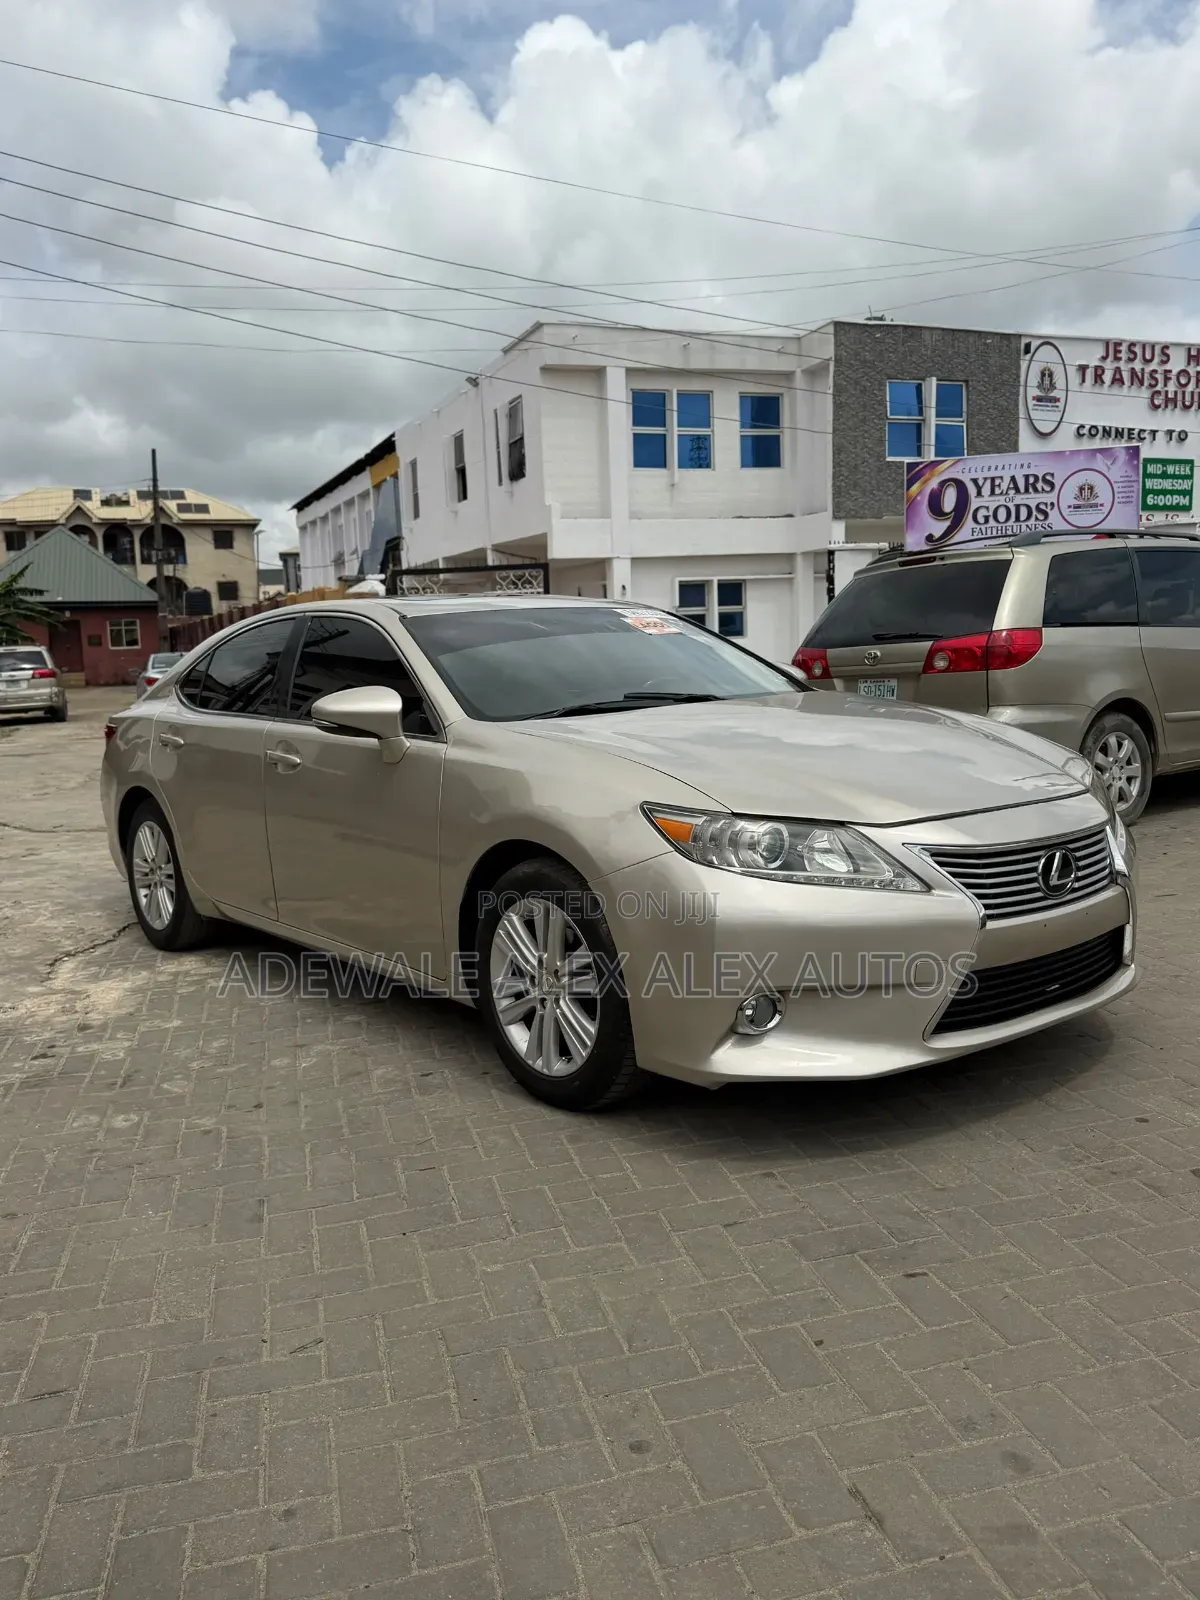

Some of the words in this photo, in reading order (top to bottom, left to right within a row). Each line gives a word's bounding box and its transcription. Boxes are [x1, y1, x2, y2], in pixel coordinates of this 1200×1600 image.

[1100, 341, 1171, 365] JESUS
[1150, 389, 1200, 410] CHU
[1076, 424, 1159, 441] CONNECT
[1165, 429, 1189, 442] TO
[961, 462, 1032, 474] CELEBRATING
[1146, 463, 1191, 475] MID-WEEK
[1145, 478, 1193, 491] WEDNESDAY
[1004, 495, 1017, 504] OF
[1146, 494, 1190, 506] 6:00PM
[924, 477, 972, 547] 9
[969, 471, 1056, 498] YEARS
